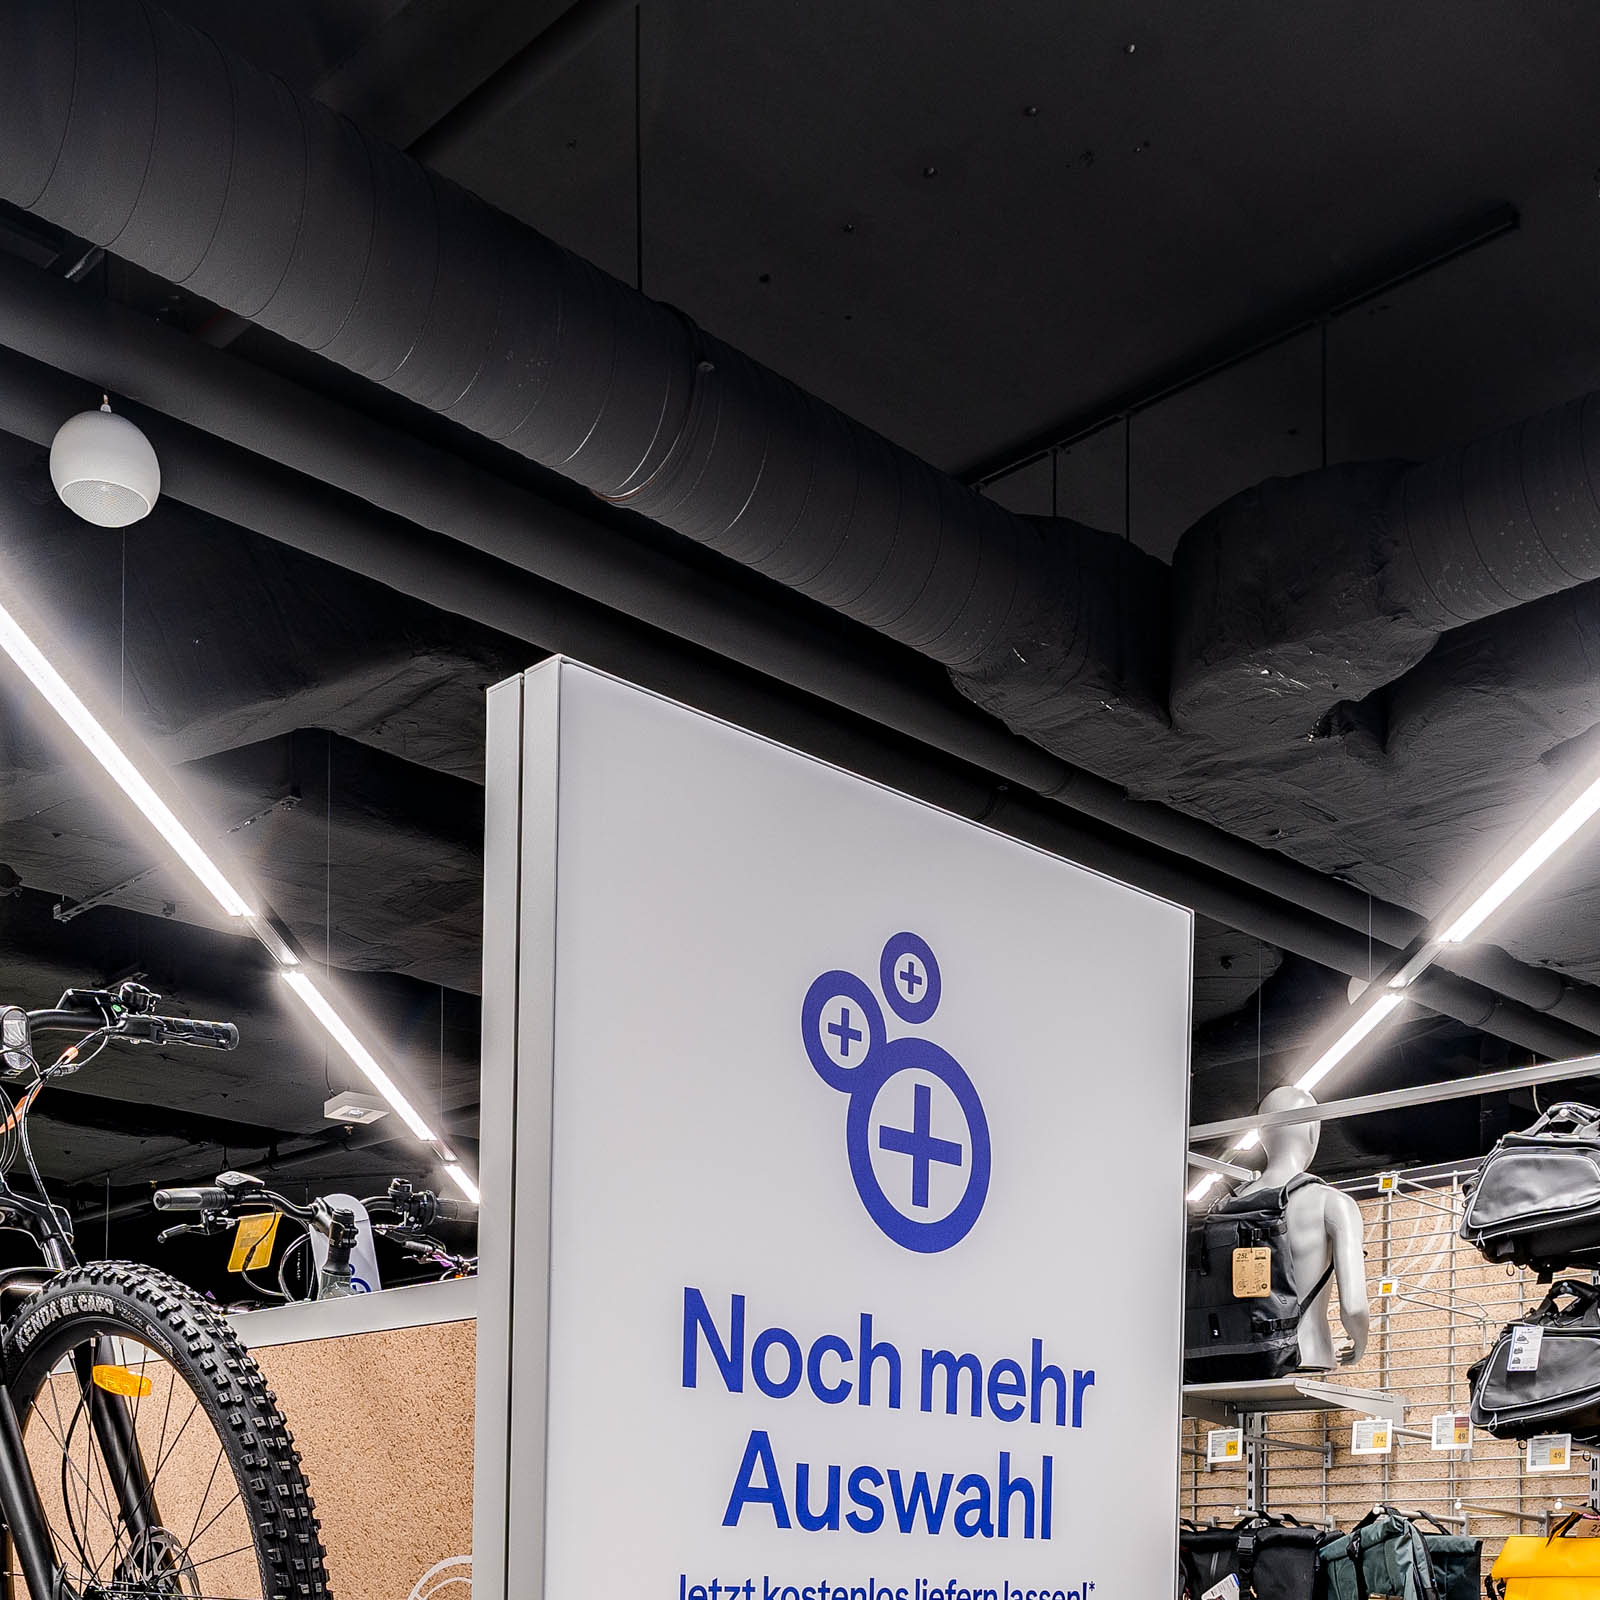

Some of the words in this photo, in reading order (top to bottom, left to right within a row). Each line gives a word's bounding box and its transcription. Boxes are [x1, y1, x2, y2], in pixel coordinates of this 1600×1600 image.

[15, 1300, 61, 1353] KENDA
[59, 1296, 79, 1316] EL
[77, 1294, 114, 1315] CAPO
[683, 1287, 901, 1409] Noch
[921, 1338, 1095, 1428] mehr
[722, 1430, 1054, 1540] Auswahl
